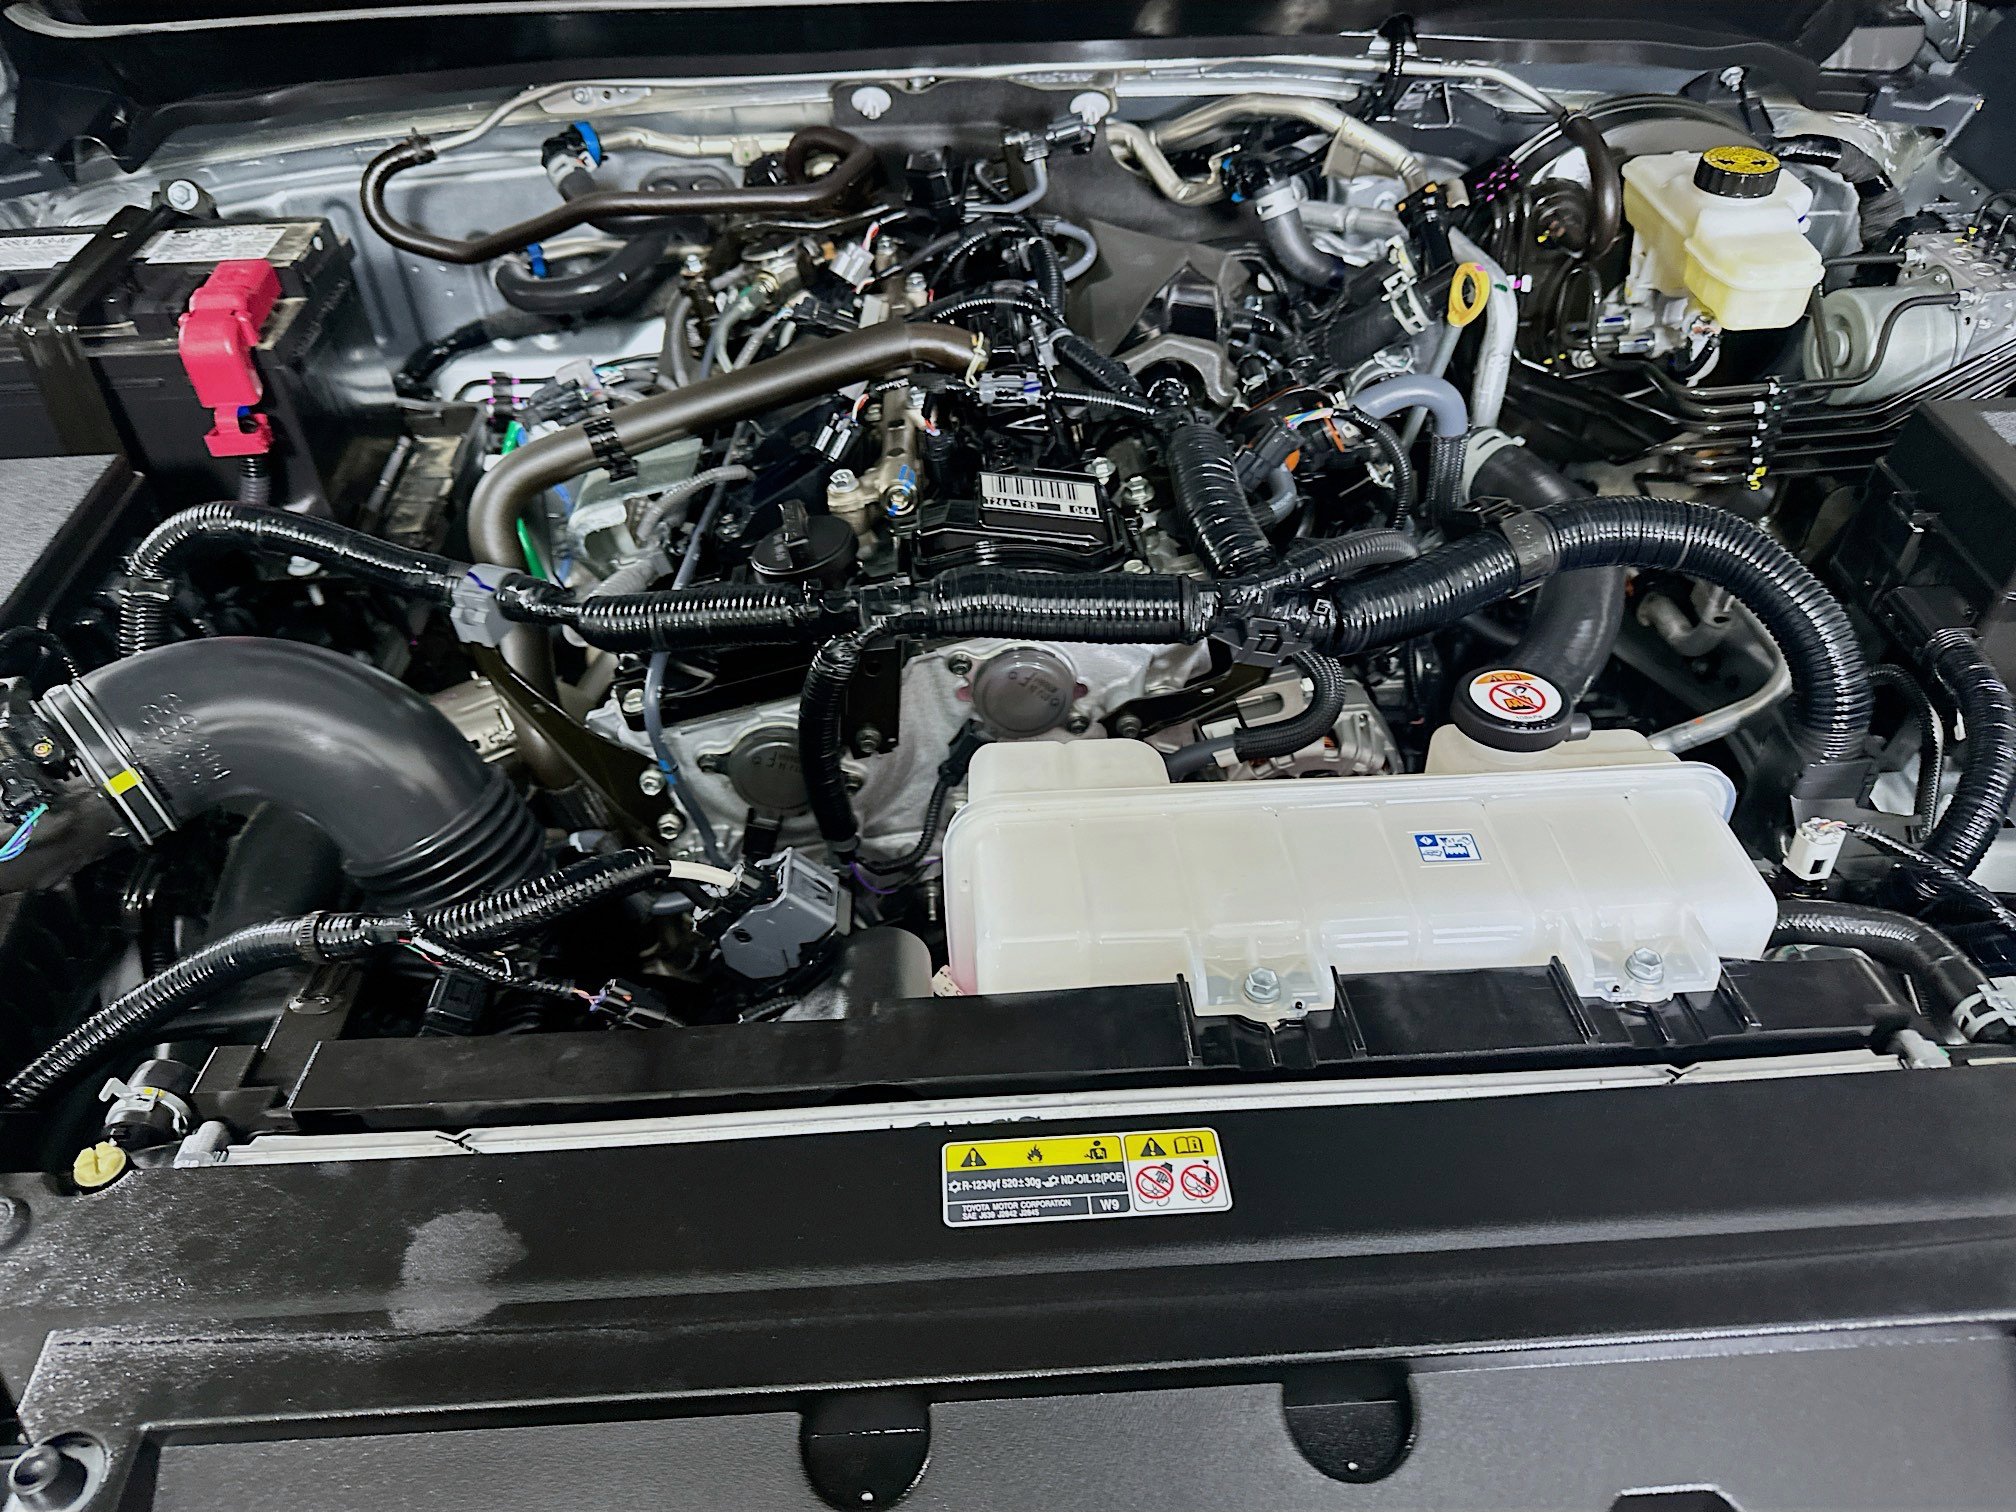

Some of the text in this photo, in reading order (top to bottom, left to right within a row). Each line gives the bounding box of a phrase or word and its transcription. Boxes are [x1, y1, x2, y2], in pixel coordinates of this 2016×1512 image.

[962, 1171, 1126, 1192] R-1234yf 520±30g ND-OIL12(POE)
[962, 1199, 1072, 1213] TOYOTA MOTOR CORPORATION
[1099, 1198, 1120, 1211] W9
[962, 1212, 978, 1221] SAE
